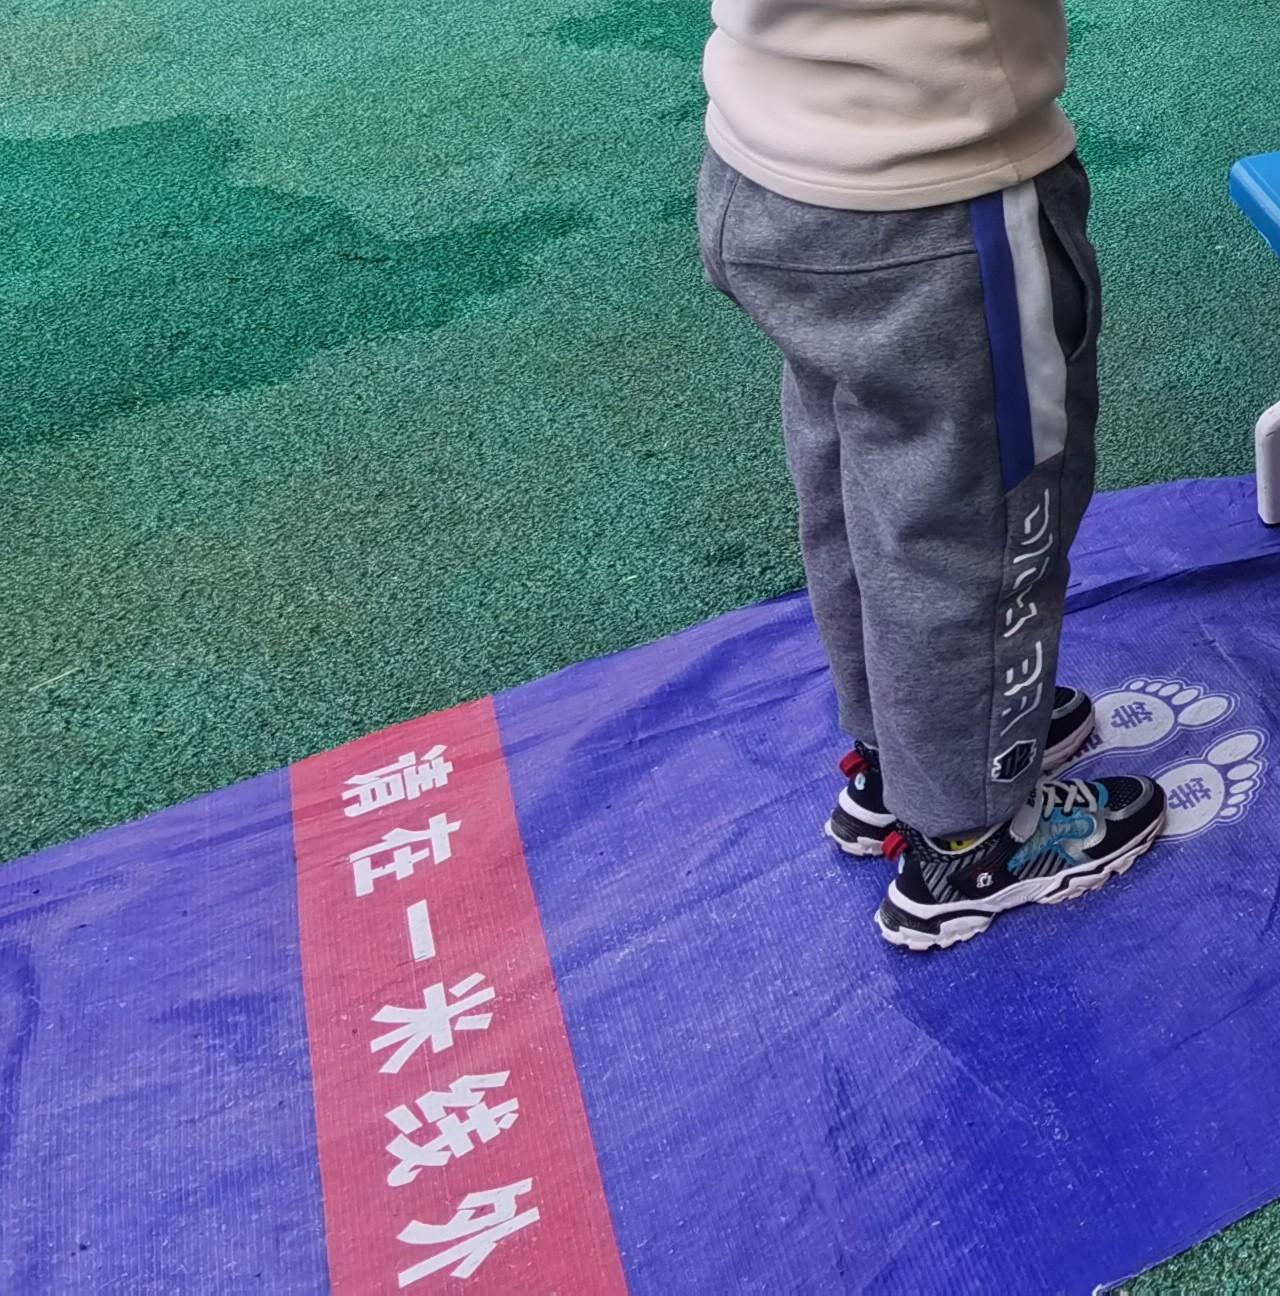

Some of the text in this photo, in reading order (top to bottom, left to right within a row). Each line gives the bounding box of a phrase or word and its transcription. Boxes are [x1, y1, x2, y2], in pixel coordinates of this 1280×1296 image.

[342, 745, 541, 1289] 请在一米线外
